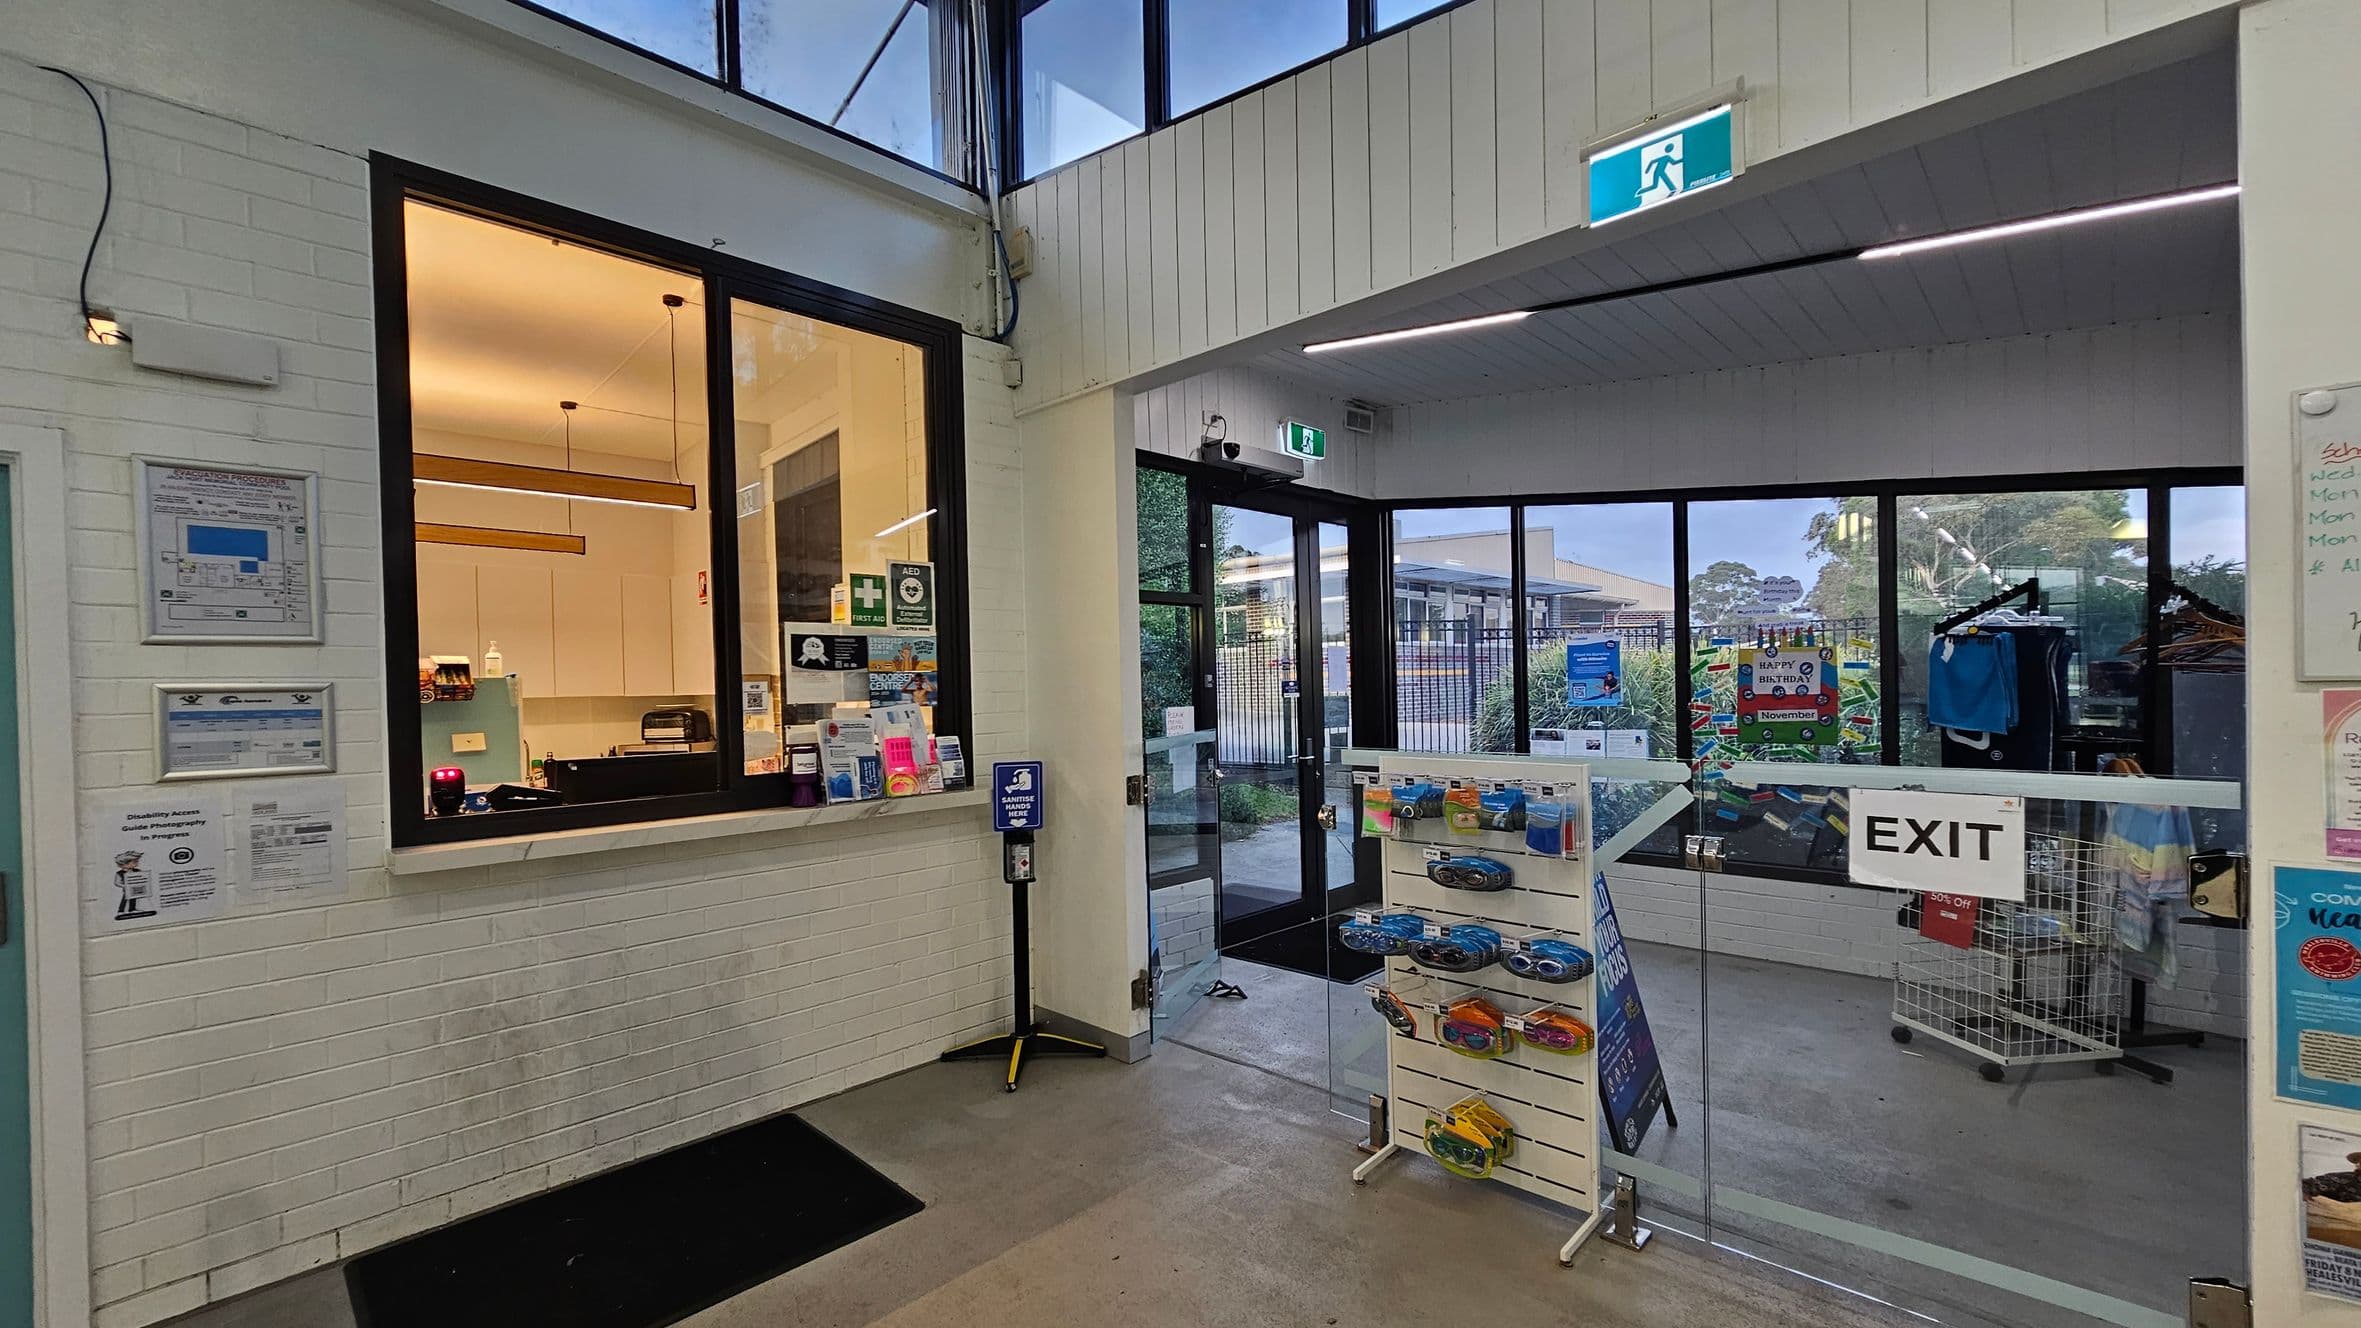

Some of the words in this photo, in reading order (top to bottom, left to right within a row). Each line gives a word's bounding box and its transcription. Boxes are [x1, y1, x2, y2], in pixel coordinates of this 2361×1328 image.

[2320, 442, 2361, 461] Sch
[231, 473, 286, 485] PROCEDURES
[2310, 487, 2359, 503] Mon
[2308, 509, 2355, 525] Mon
[2308, 533, 2358, 548] Mon
[902, 567, 920, 576] AED
[853, 614, 871, 622] FIRST
[1759, 660, 1796, 670] HAPPY
[1759, 674, 1813, 683] BIRTHDAY
[1761, 711, 1815, 720] November
[2345, 732, 2361, 744] R
[127, 812, 170, 820] Disability
[150, 820, 206, 829] Photography
[1866, 815, 2004, 861] EXIT
[1930, 892, 1951, 904] 50%
[1953, 897, 1972, 909] Off
[1598, 944, 1628, 998] FOCUS
[2305, 1258, 2342, 1274] FRIDAY
